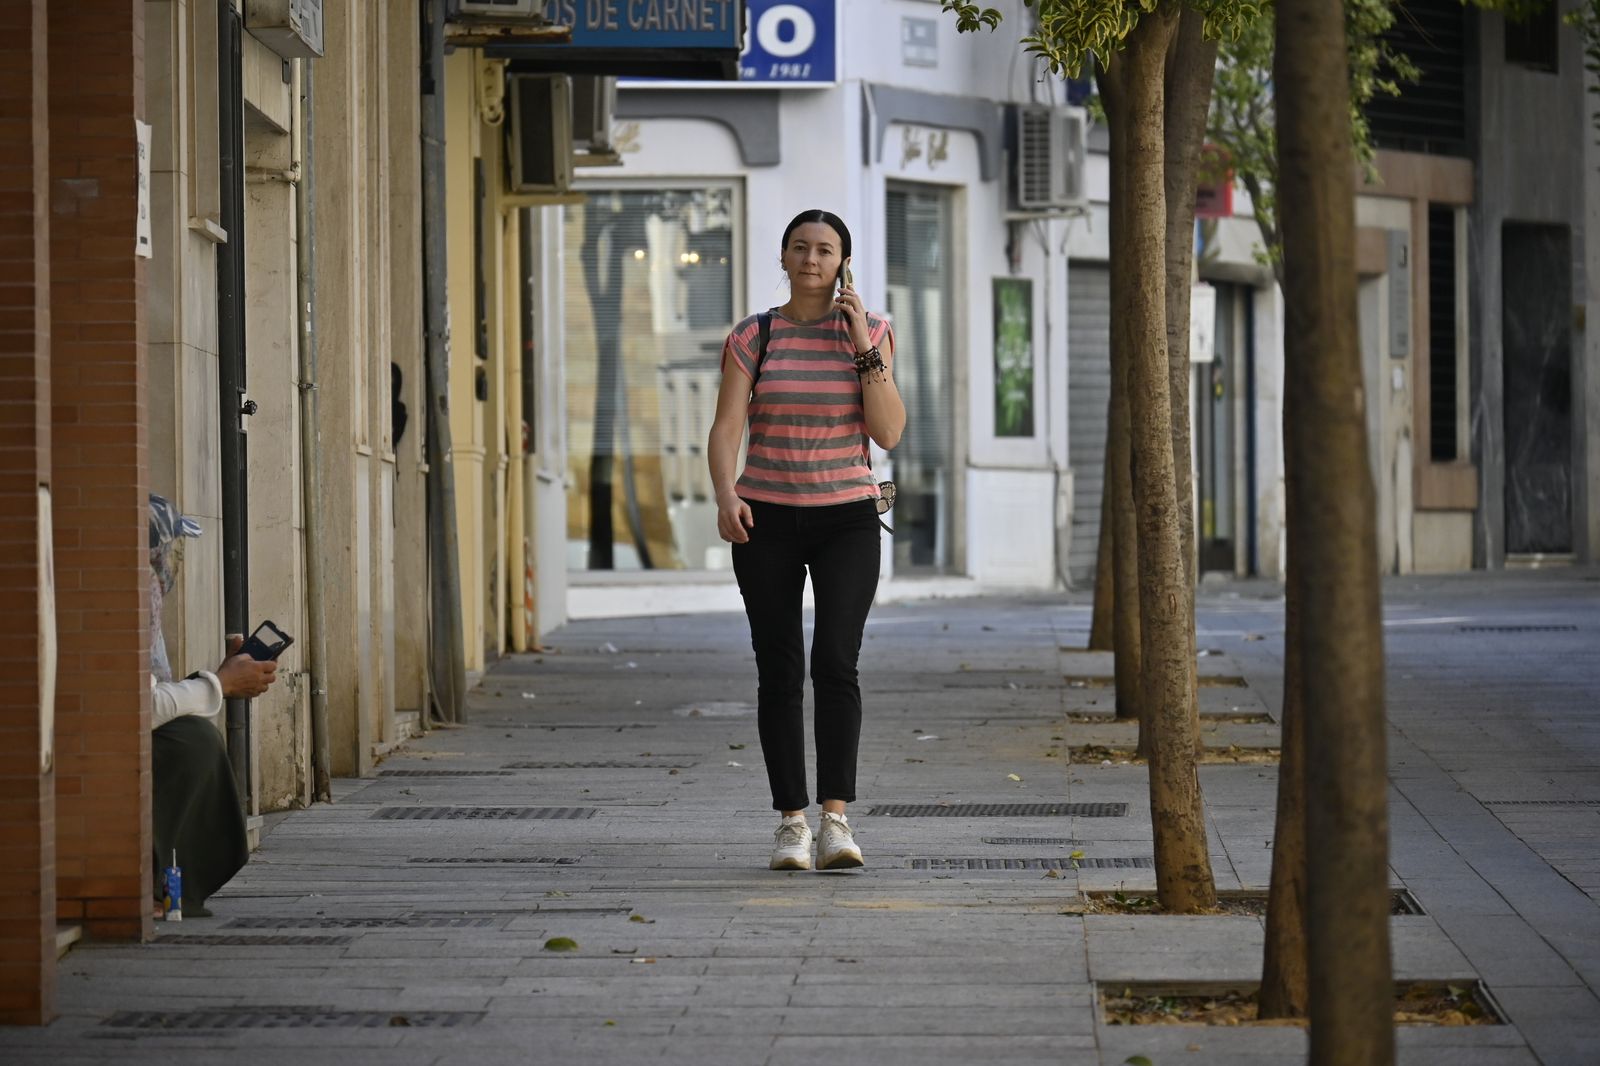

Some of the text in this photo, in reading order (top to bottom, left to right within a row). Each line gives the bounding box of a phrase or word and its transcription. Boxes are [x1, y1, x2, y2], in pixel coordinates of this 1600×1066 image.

[543, 0, 730, 31] OS DE CARNET
[769, 63, 811, 79] 1981
